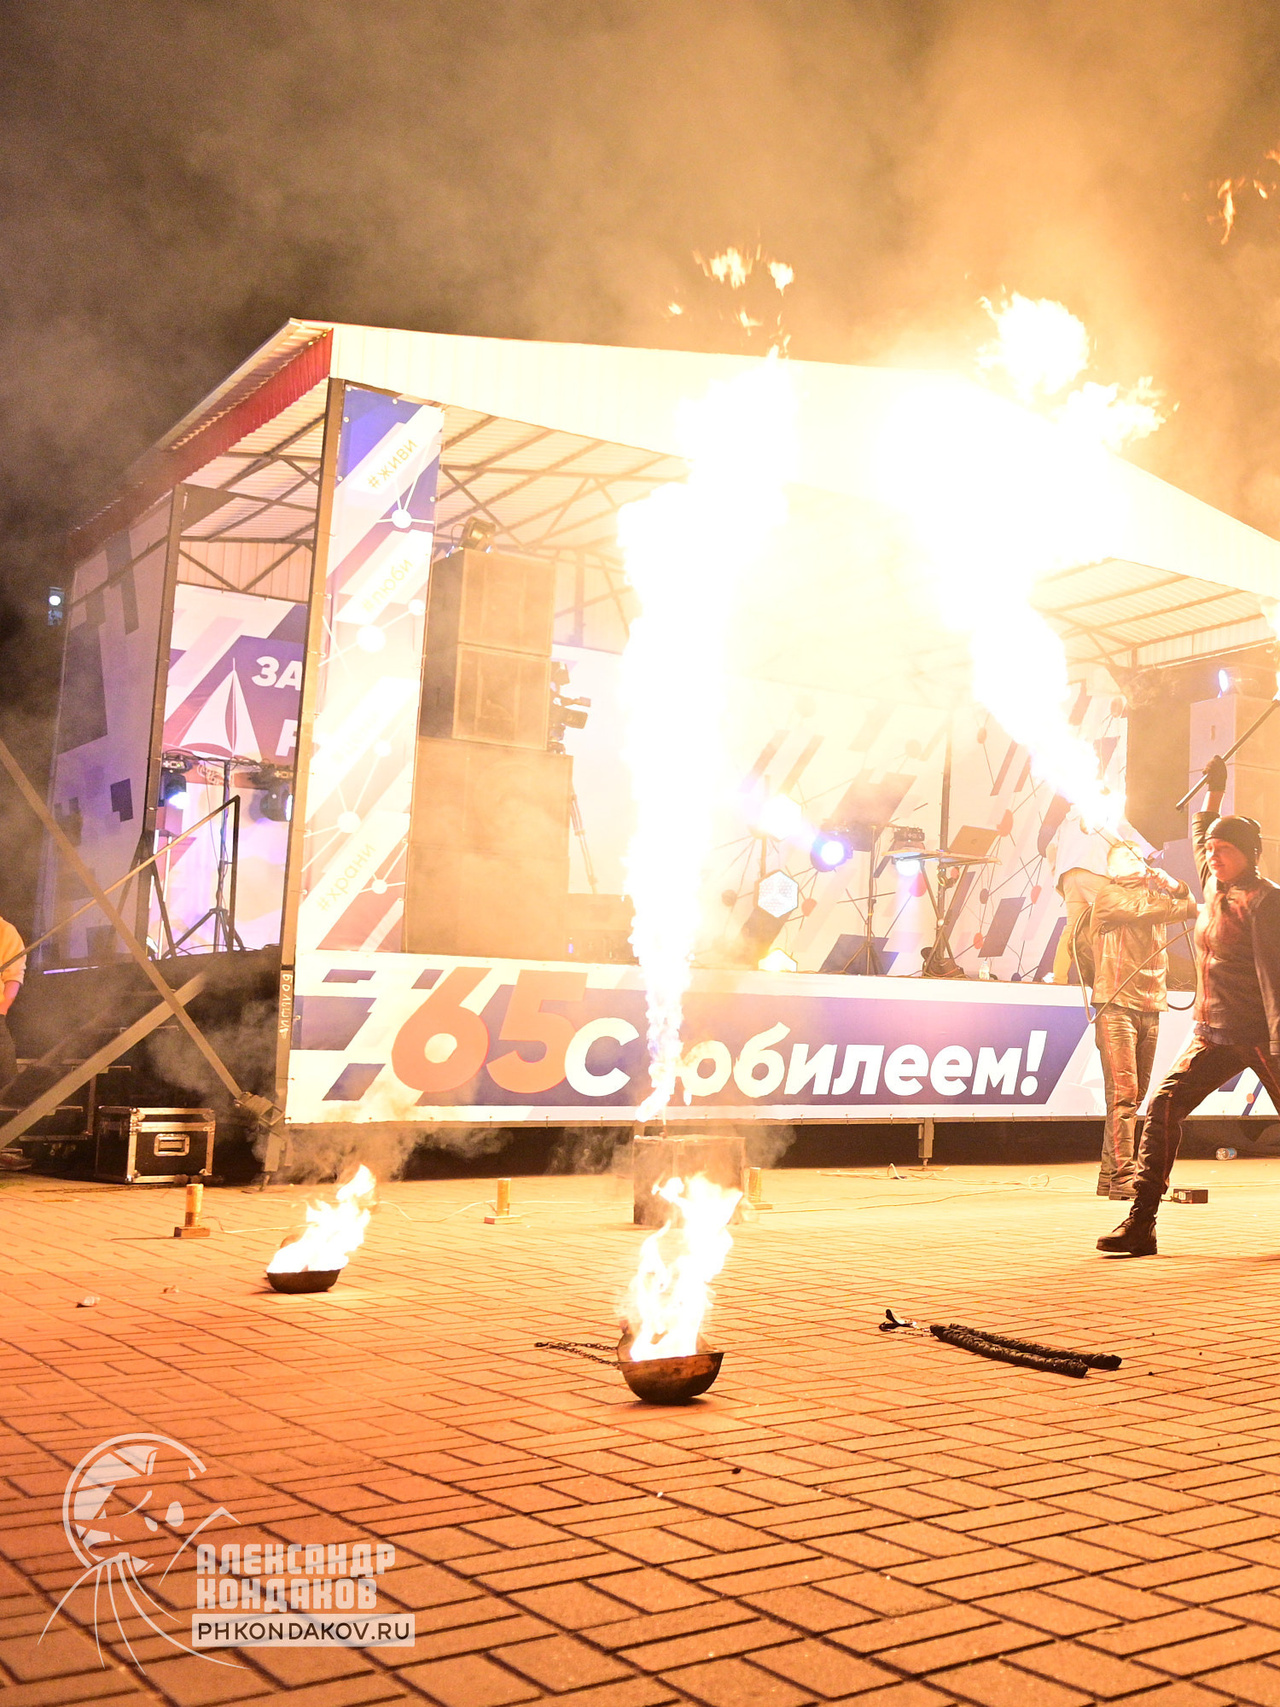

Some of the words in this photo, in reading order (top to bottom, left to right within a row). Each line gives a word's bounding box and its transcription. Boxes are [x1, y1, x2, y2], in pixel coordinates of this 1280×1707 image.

[367, 439, 418, 489] #живи
[316, 843, 376, 911] #храни
[392, 966, 587, 1094] 65
